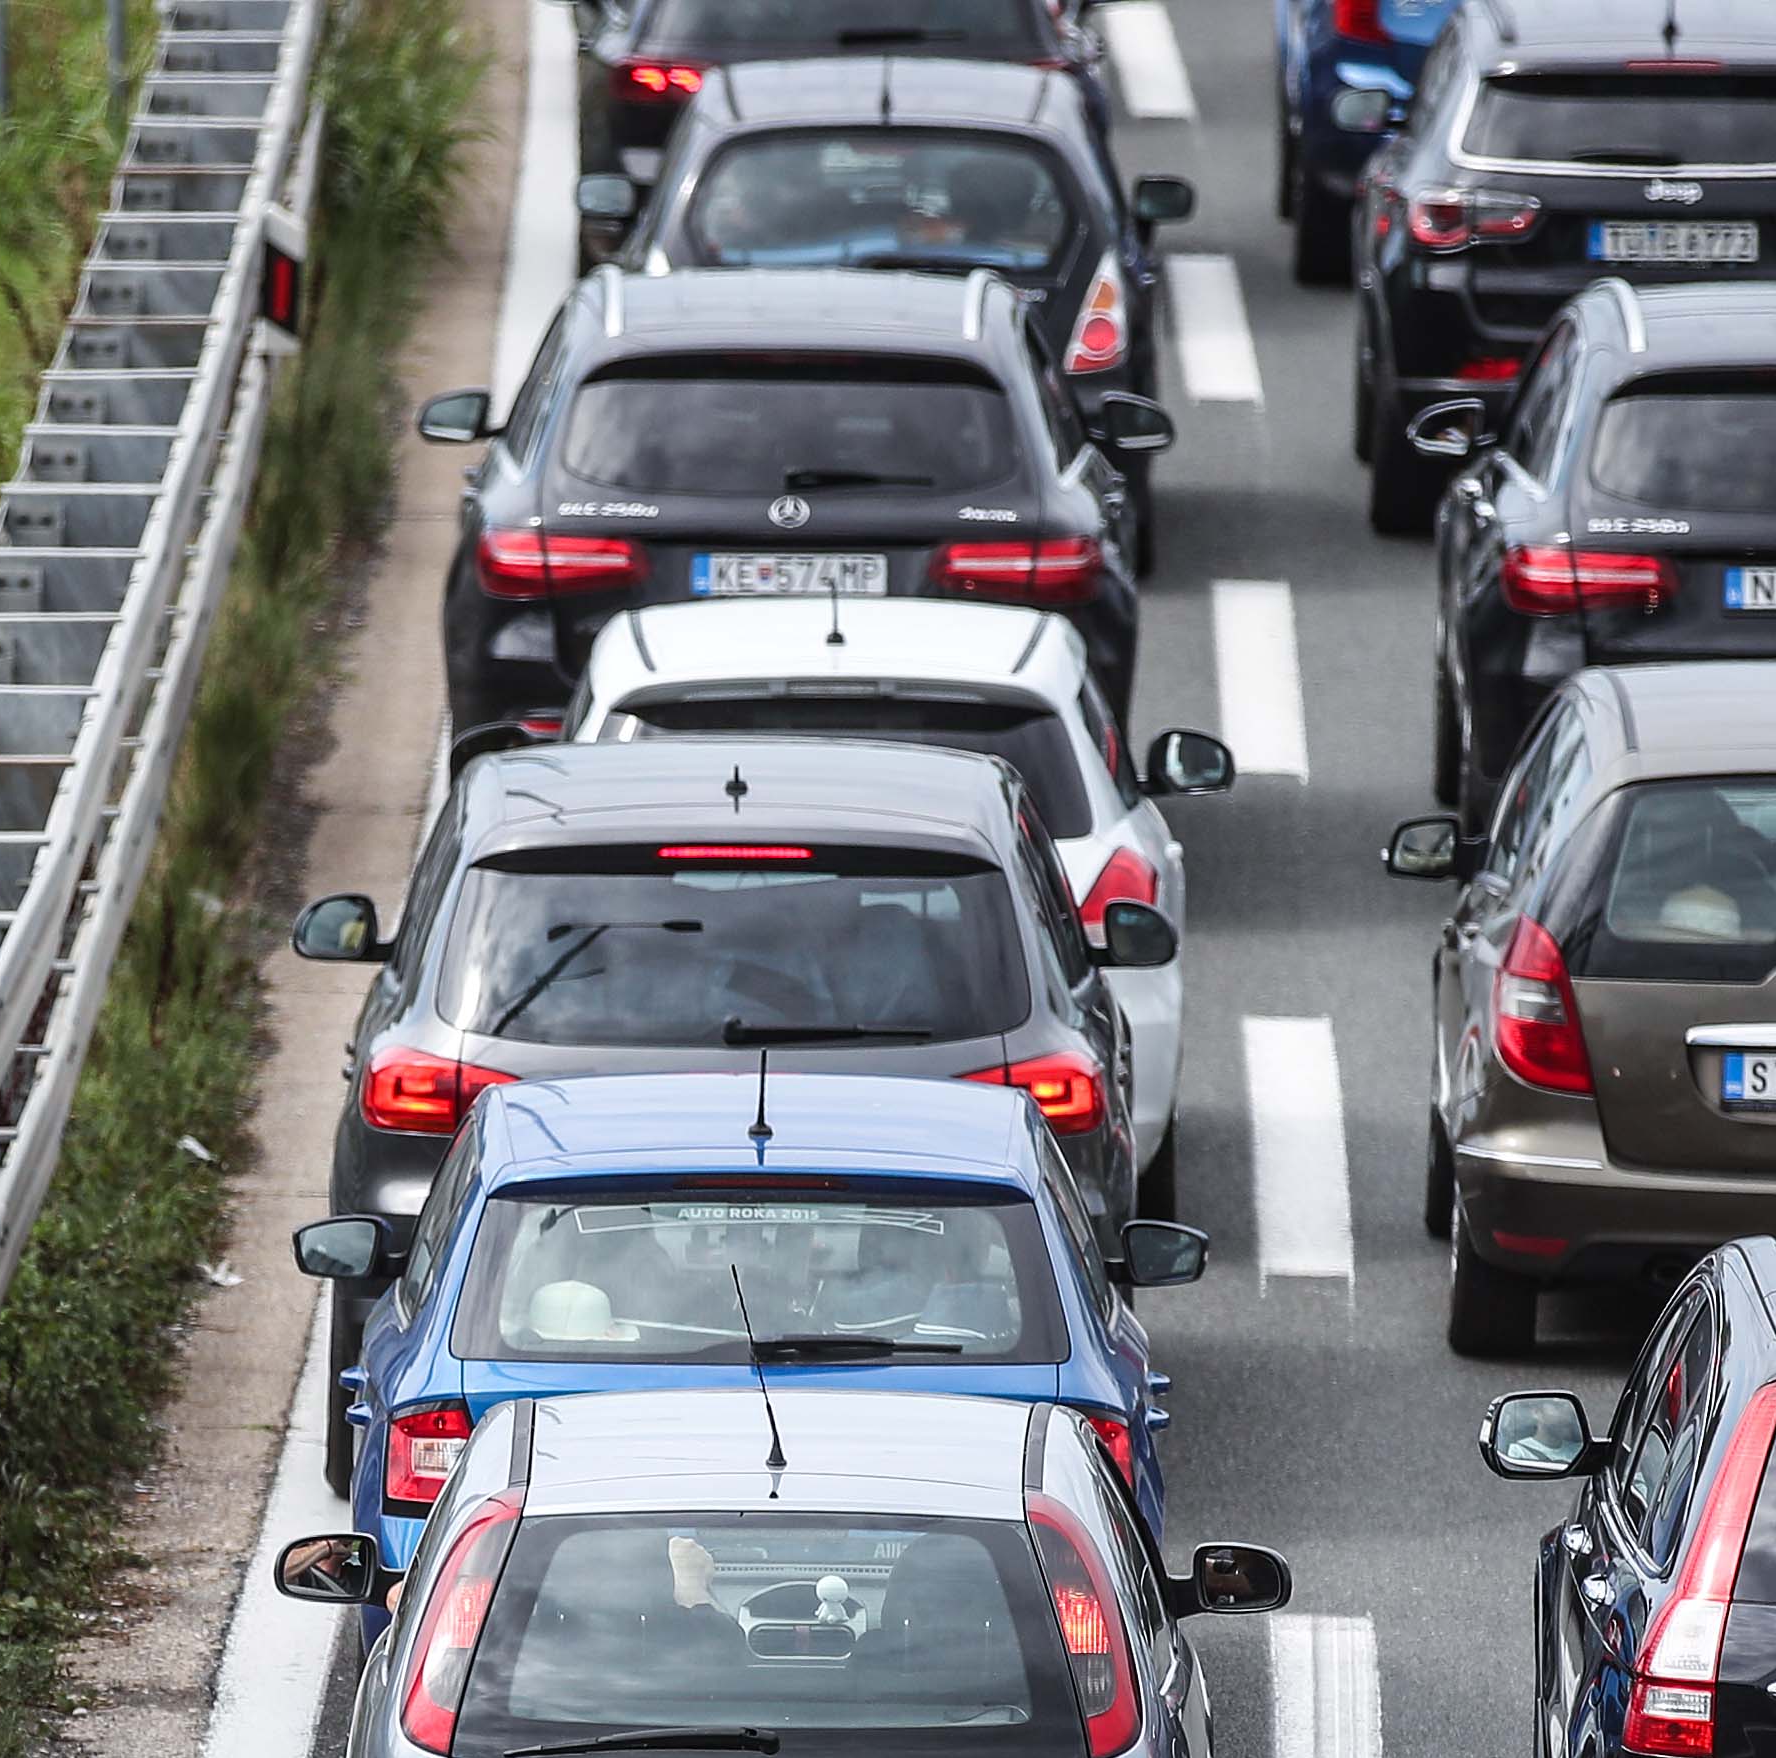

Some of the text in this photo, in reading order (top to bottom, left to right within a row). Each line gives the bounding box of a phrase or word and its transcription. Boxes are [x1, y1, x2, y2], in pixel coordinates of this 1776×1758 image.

[677, 1207, 820, 1222] AUTO ROKA 2015
